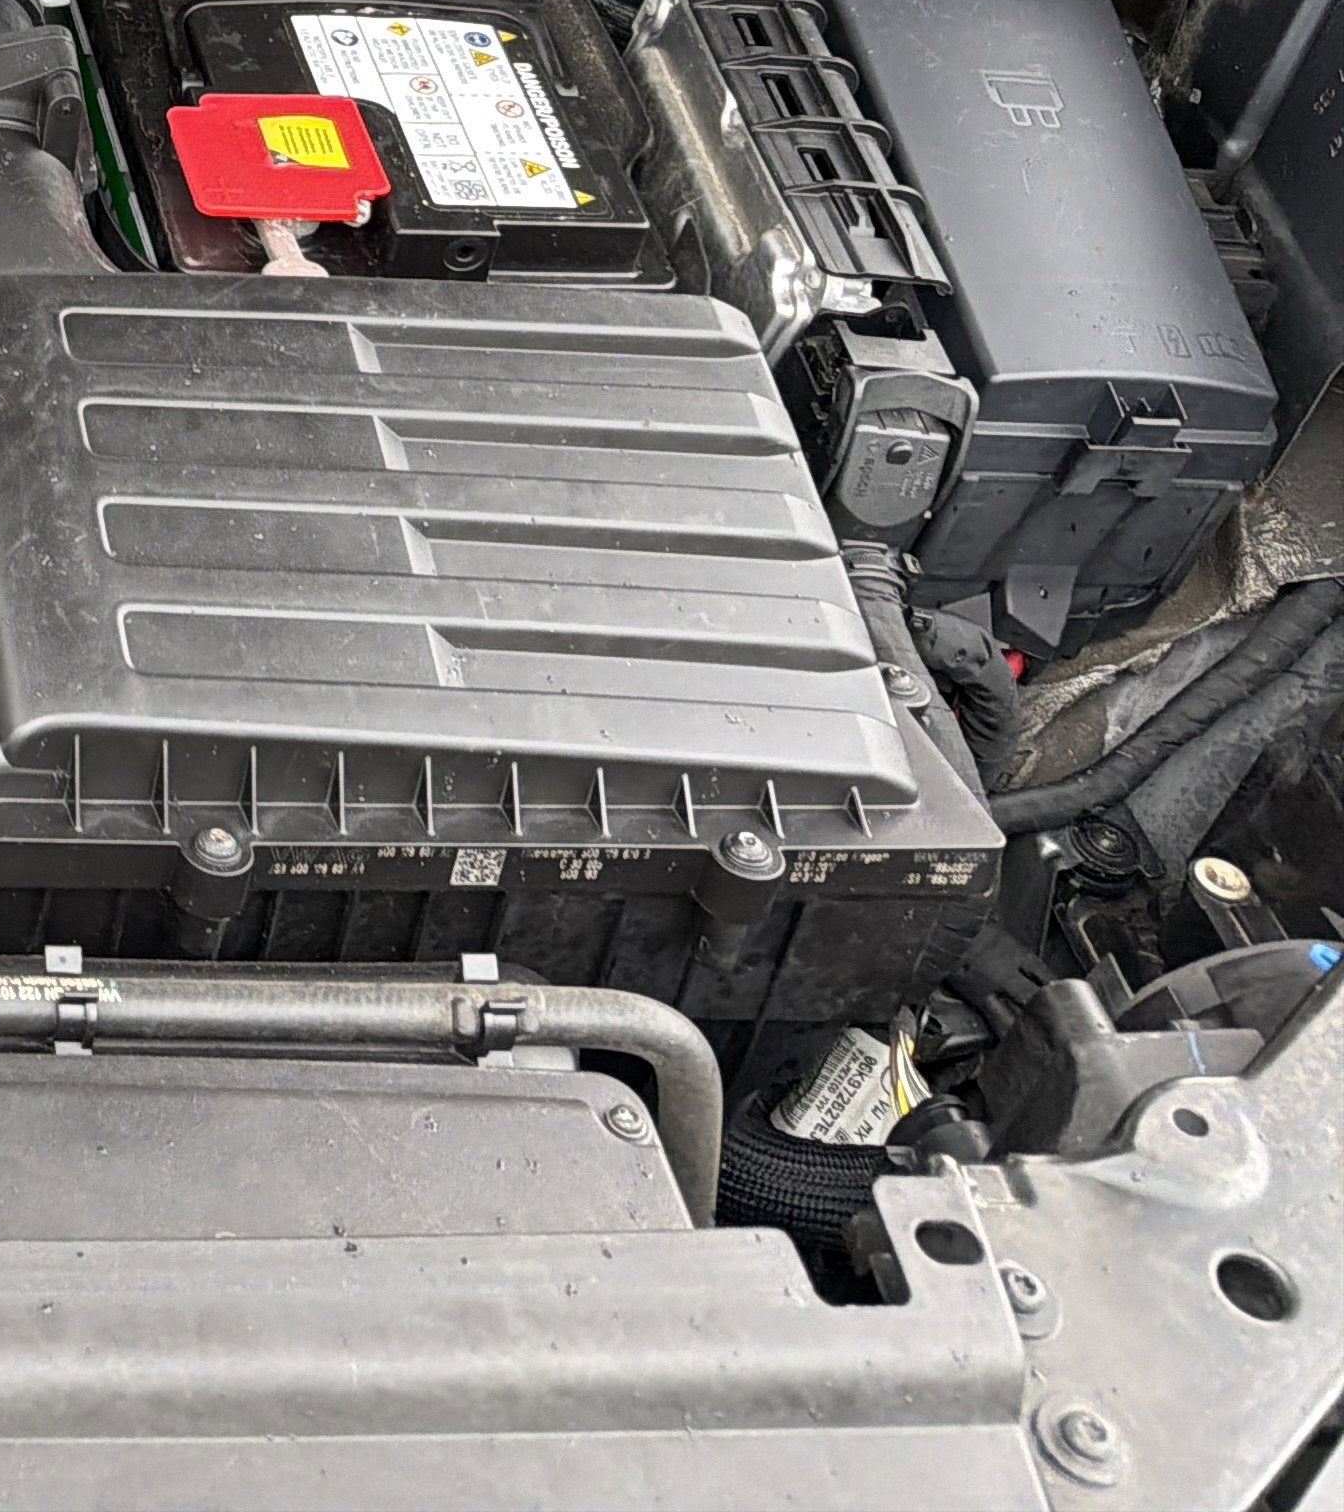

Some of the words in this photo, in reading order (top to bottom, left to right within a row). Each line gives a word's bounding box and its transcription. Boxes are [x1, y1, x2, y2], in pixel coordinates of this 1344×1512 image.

[513, 62, 581, 169] DANGER/POISON
[871, 1098, 891, 1120] VW
[853, 1120, 874, 1143] MX
